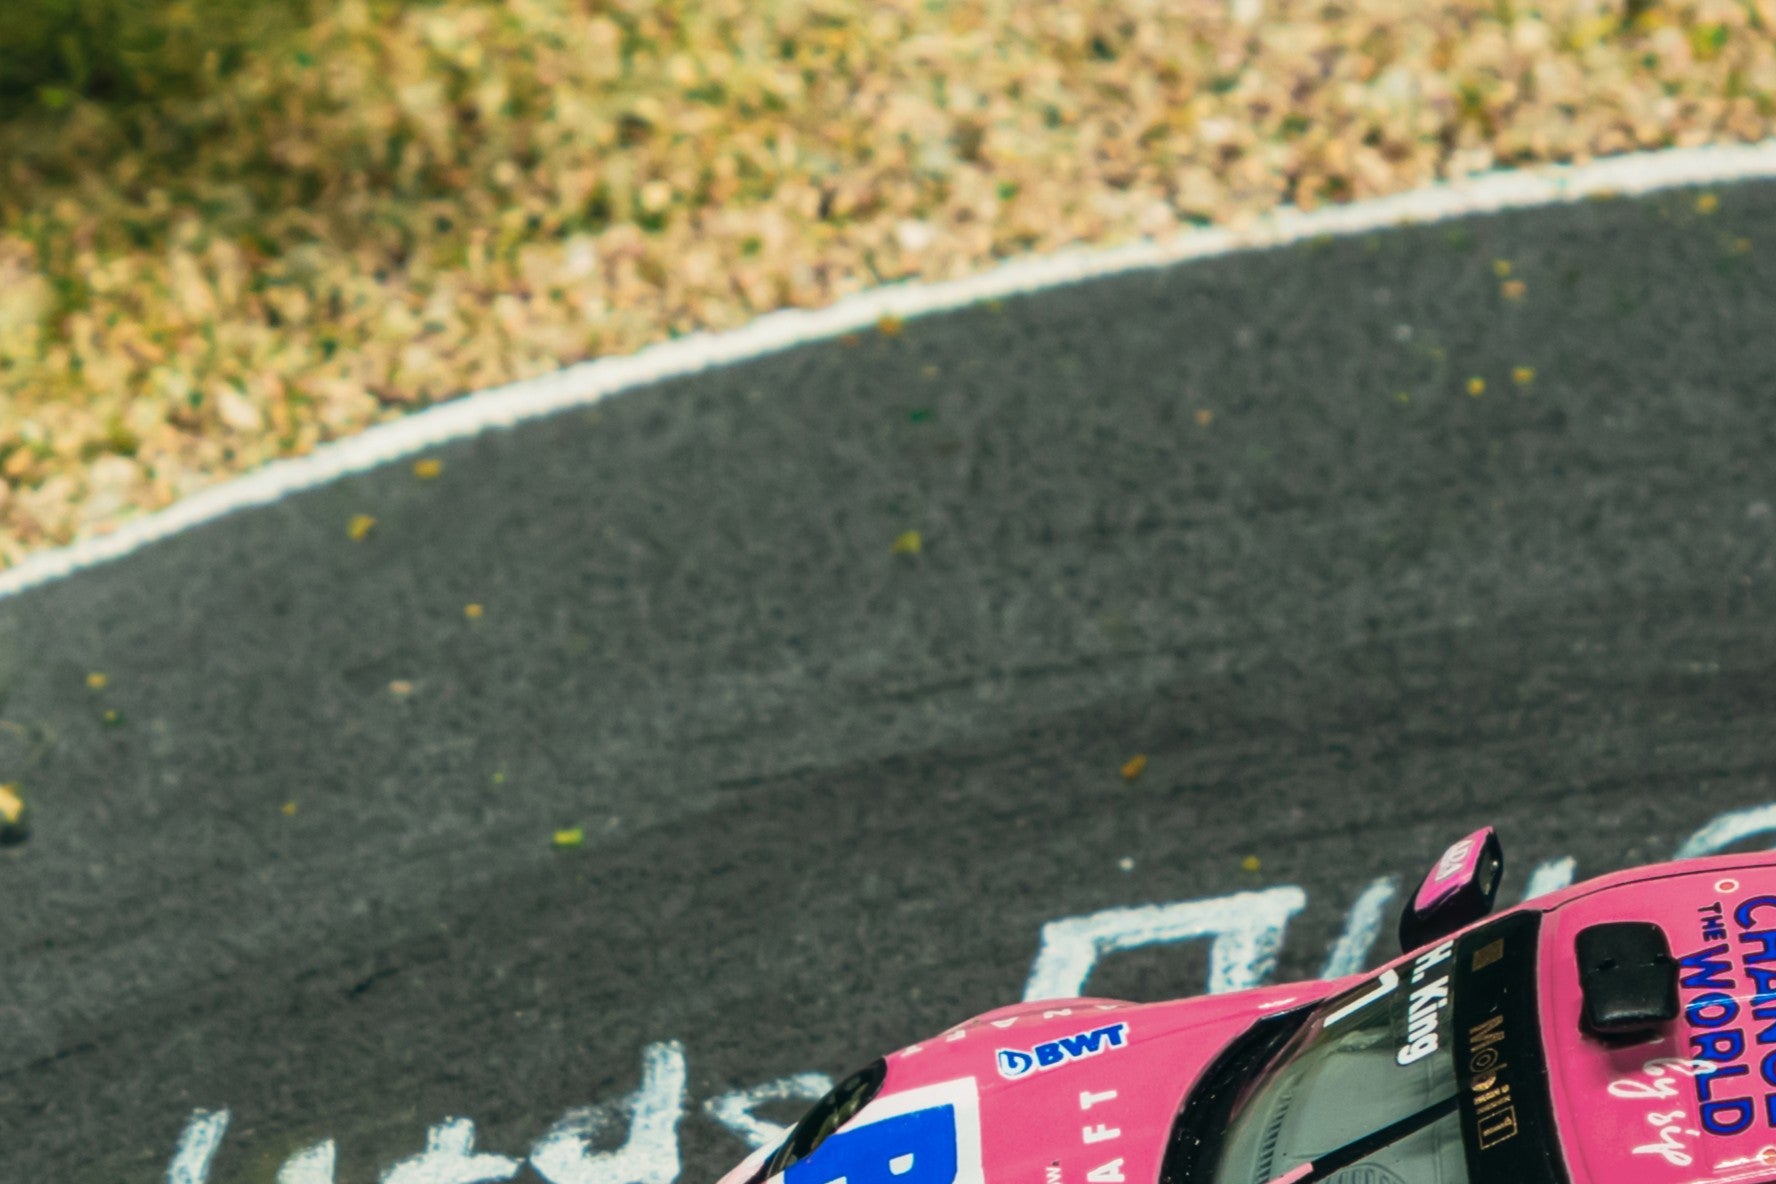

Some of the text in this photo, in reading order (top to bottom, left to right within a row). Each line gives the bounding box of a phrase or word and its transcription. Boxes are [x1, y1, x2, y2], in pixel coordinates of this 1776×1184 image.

[1033, 1024, 1126, 1069] BWT
[1398, 973, 1449, 1066] King
[1469, 1015, 1509, 1113] Mobil
[1678, 903, 1755, 1136] THE WORLD
